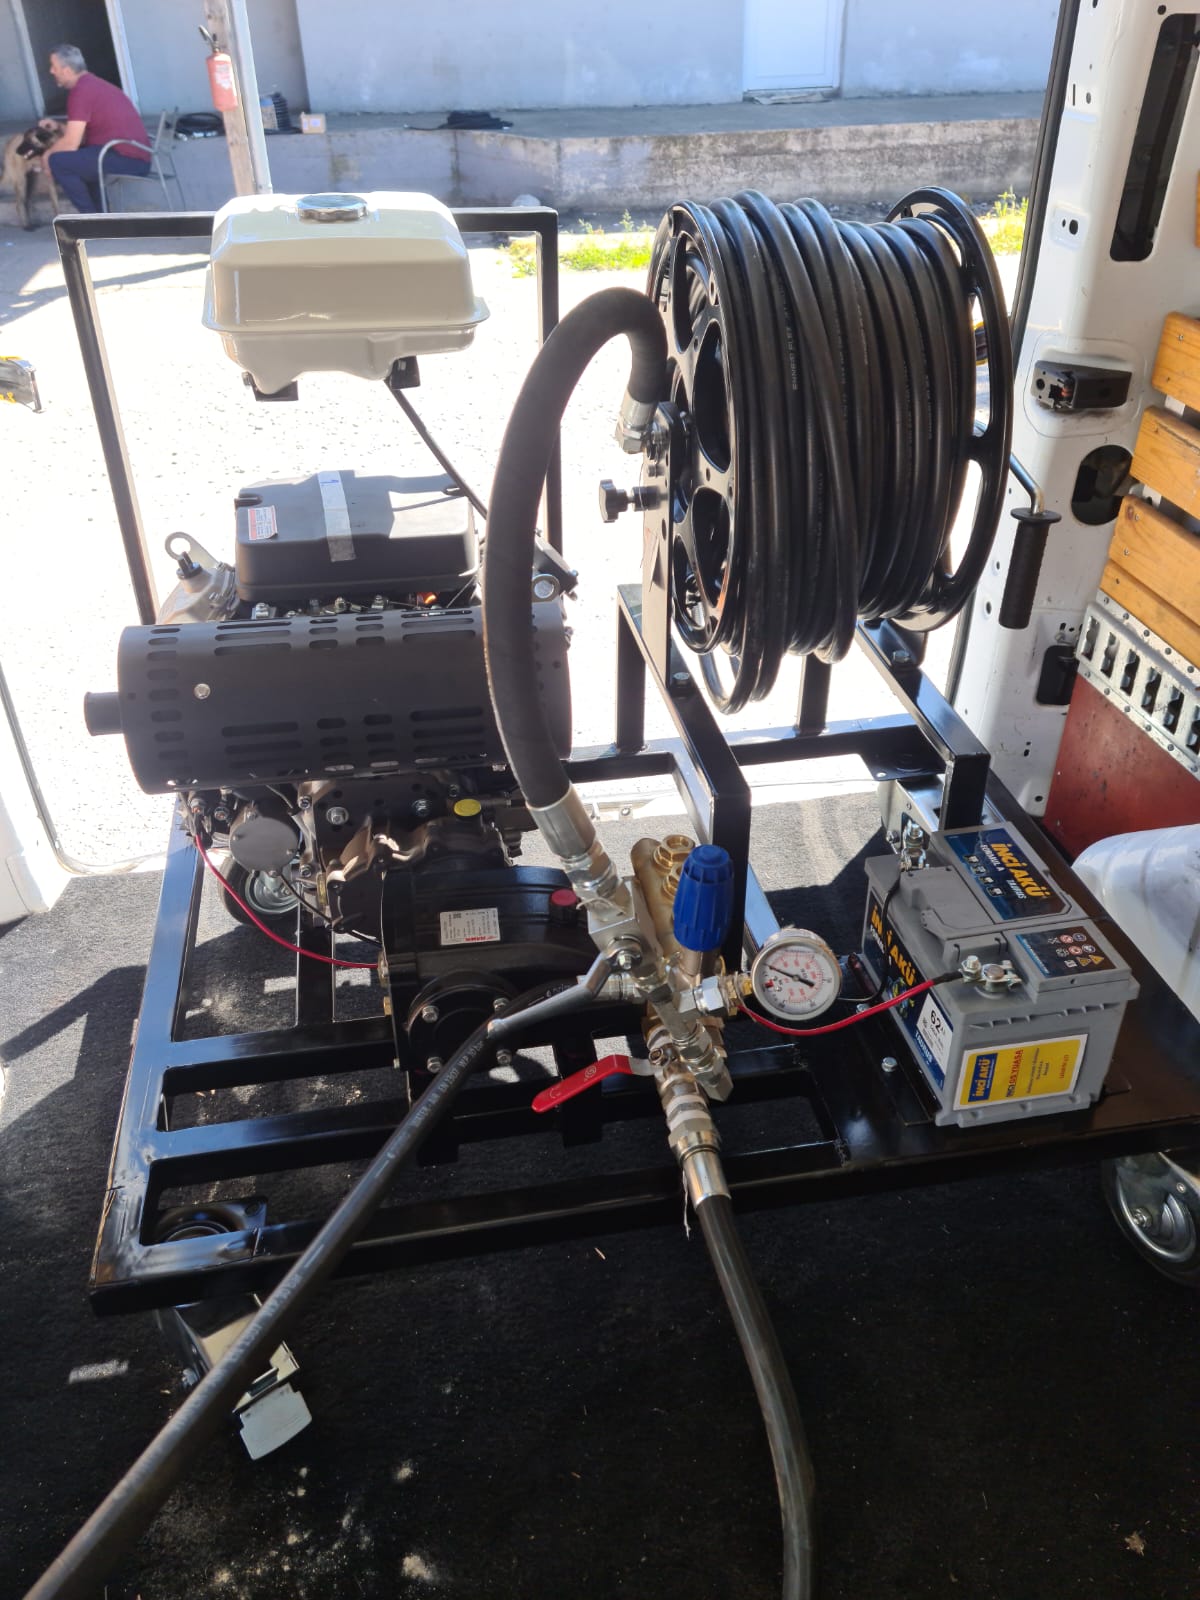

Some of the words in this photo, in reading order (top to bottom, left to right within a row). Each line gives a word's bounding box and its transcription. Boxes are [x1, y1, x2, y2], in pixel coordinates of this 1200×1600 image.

[1009, 868, 1050, 897] AKÜ
[889, 944, 916, 987] AKÜ
[930, 1009, 942, 1034] 62
[978, 1057, 991, 1080] AKÜ
[1011, 1048, 1024, 1075] YUASA
